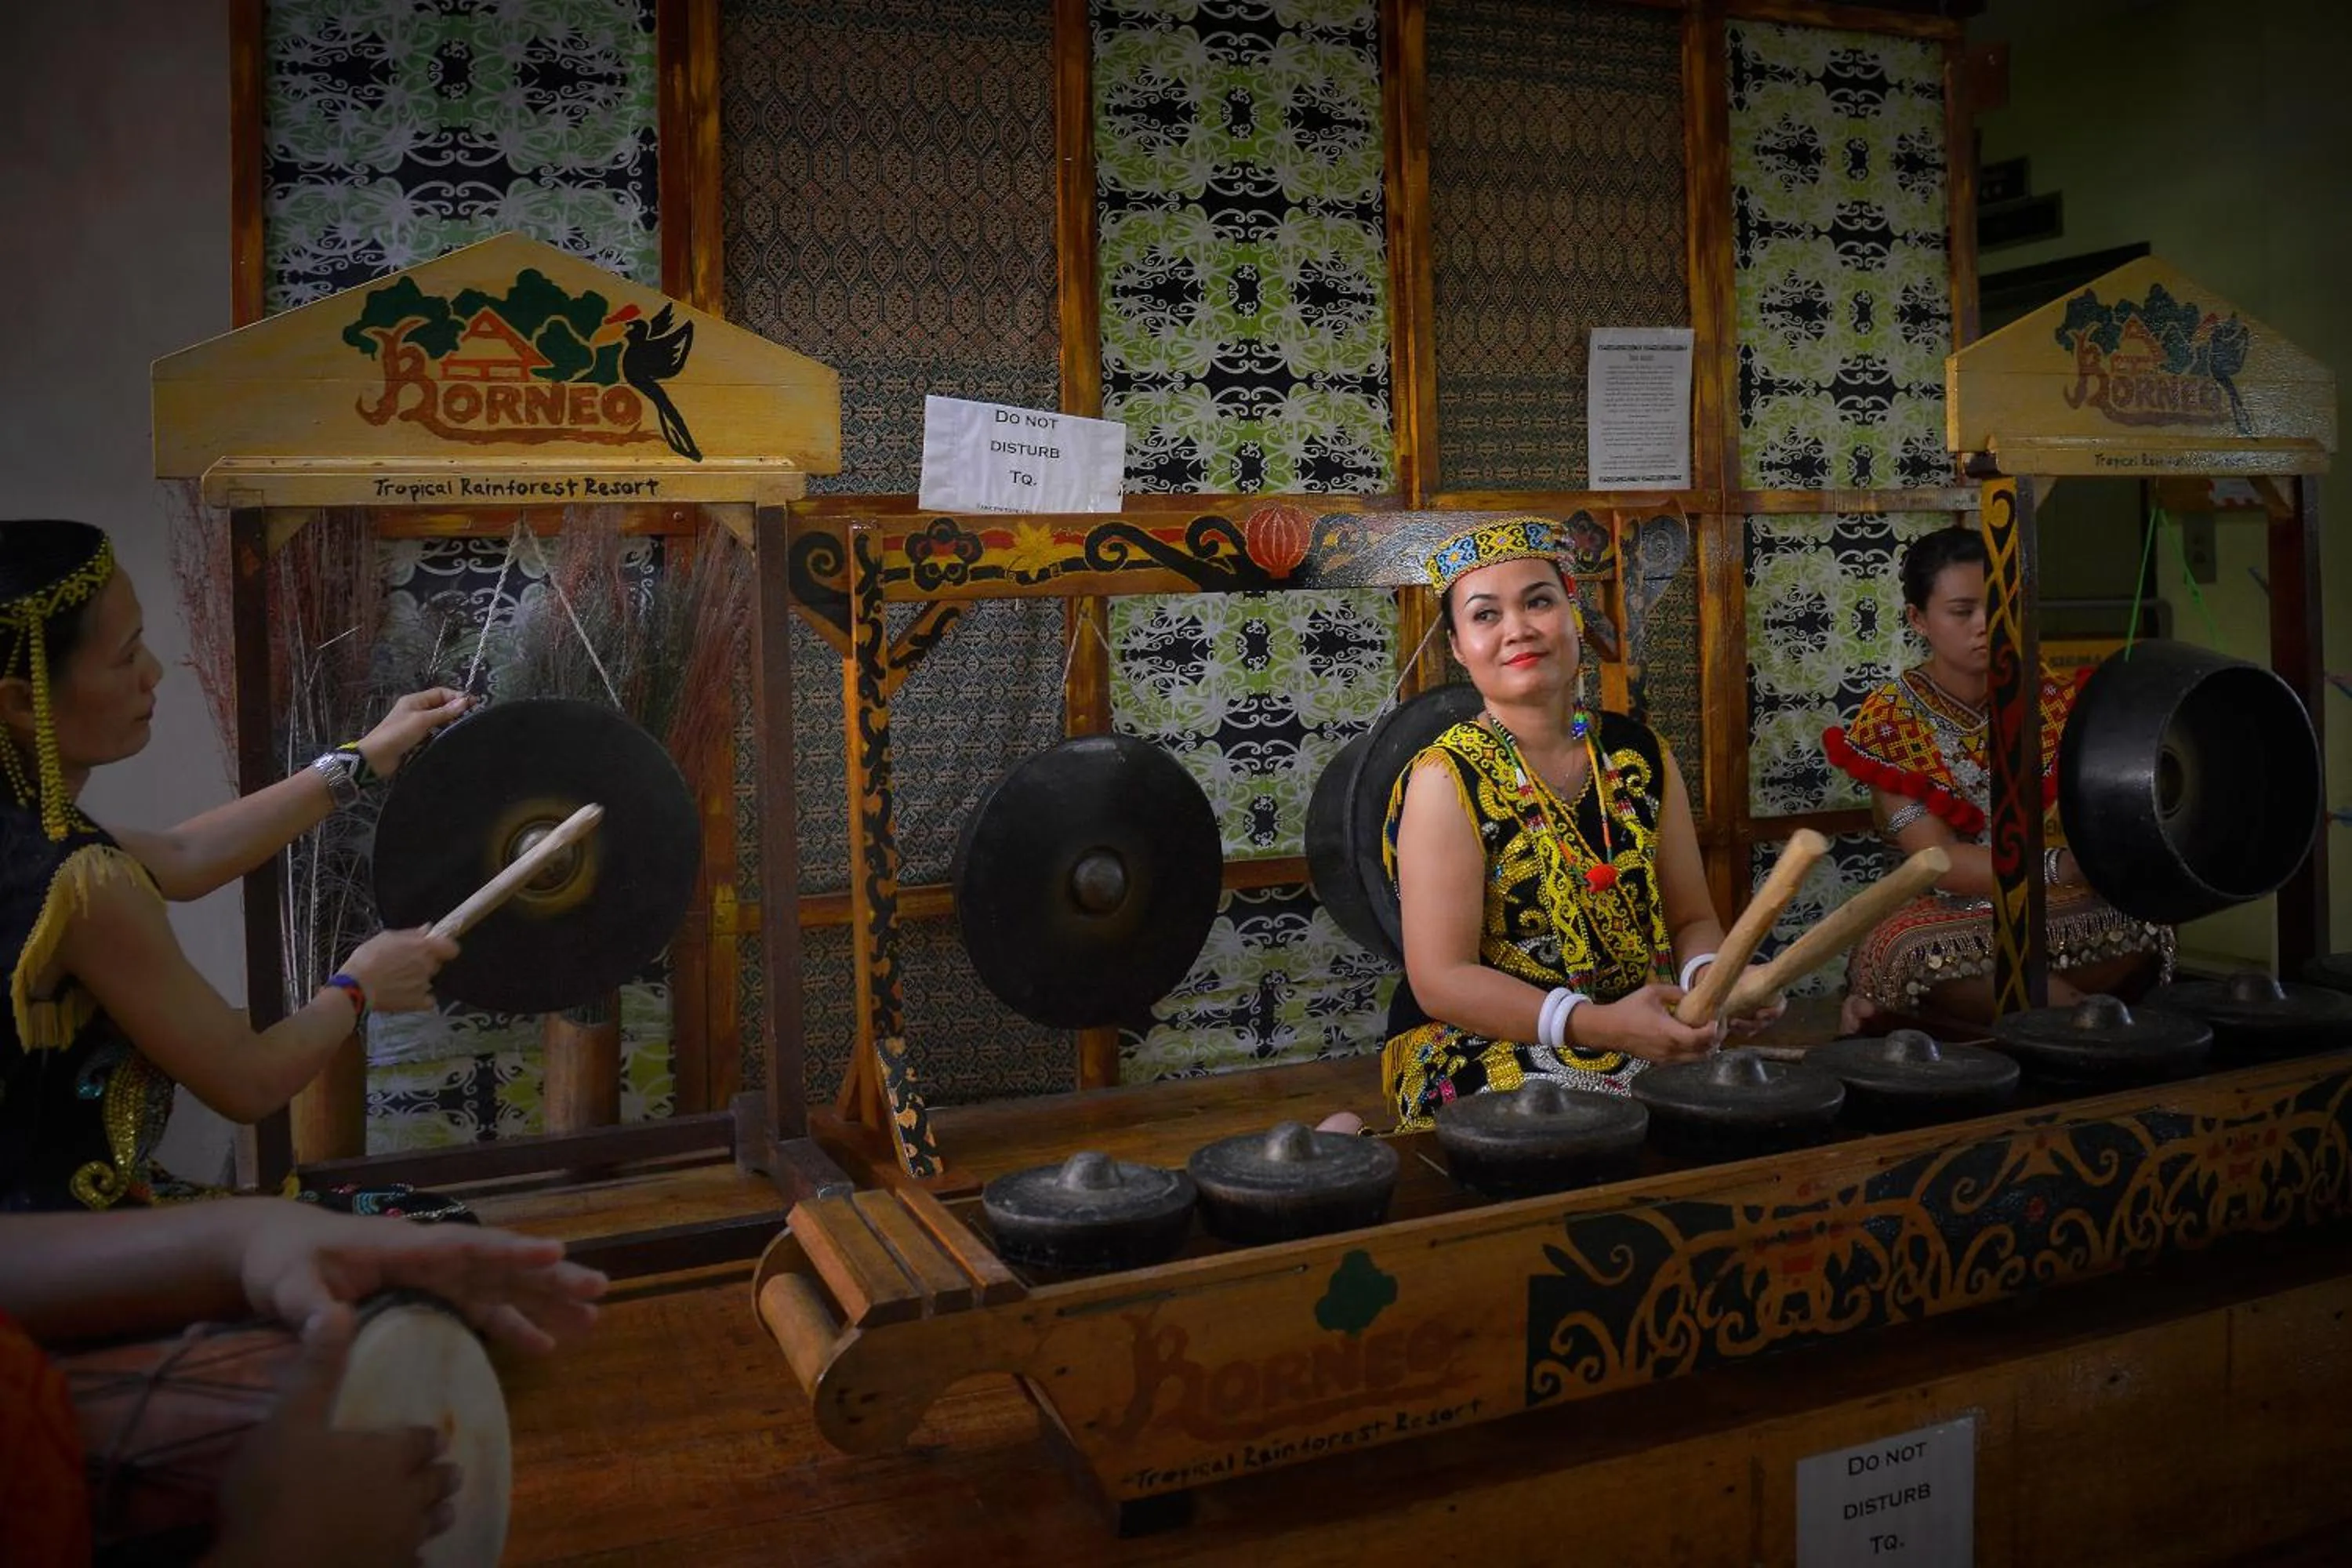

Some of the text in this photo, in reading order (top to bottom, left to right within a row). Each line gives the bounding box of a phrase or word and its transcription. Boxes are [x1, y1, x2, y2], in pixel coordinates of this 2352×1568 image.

[355, 317, 651, 445] BORNEO
[995, 409, 1058, 430] DO NOT
[990, 440, 1060, 459] DISTURB
[373, 477, 659, 501] Tropical Rainforest Resort
[1009, 470, 1037, 486] TQ.
[1099, 1307, 1462, 1443] BORNEO
[1243, 1421, 1385, 1468] Rainforest
[1395, 1399, 1484, 1433] Resort
[1848, 1442, 1927, 1475] DO NOT
[1843, 1483, 1931, 1520] DISTURB
[1869, 1534, 1905, 1554] TQ.
